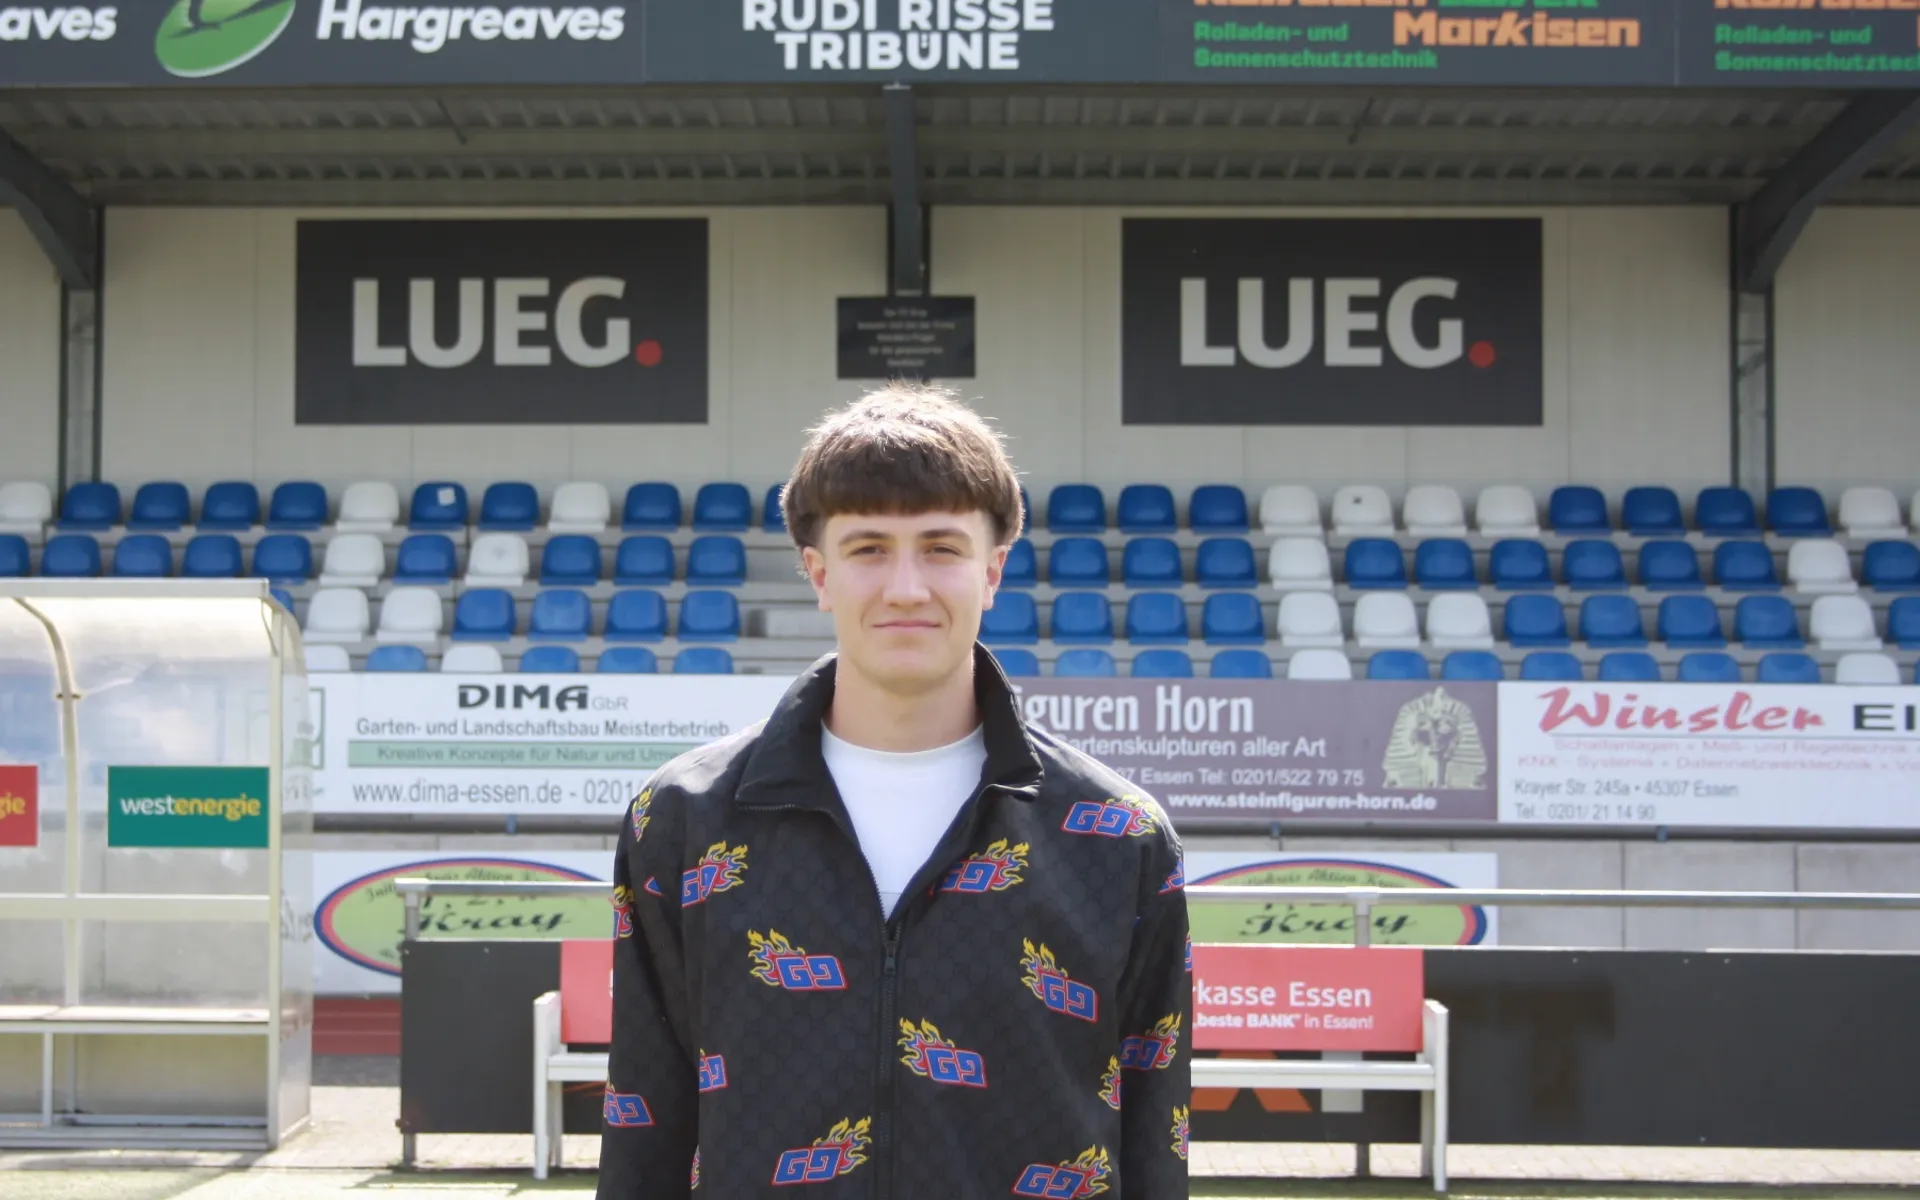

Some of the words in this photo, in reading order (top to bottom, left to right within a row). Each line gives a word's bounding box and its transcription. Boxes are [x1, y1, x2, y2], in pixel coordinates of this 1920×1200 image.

[316, 0, 626, 53] Hargreaves
[742, 0, 878, 31] RUDI
[898, 0, 1055, 31] RISSE
[1194, 21, 1303, 41] Rolladen-
[1306, 22, 1348, 42] und
[1393, 10, 1641, 47] Markisen
[1829, 24, 1872, 45] und
[774, 31, 1020, 70] TRIBÜNE
[1194, 48, 1438, 68] Sonnenschutztechnik
[1714, 51, 1920, 71] Sonnenschutztec
[458, 685, 589, 711] DIMA
[592, 697, 629, 711] GbR
[1155, 684, 1254, 733] Horn
[1537, 687, 1824, 732] Winsler
[356, 718, 422, 735] Garten-
[426, 719, 458, 736] und
[463, 720, 599, 737] Landschaftsbau
[604, 720, 730, 737] Meisterbetrieb
[377, 746, 444, 761] Kreative
[449, 746, 525, 763] Konzepte
[529, 747, 550, 761] für
[556, 748, 599, 761] Natur
[604, 748, 635, 762] und
[1056, 734, 1236, 760] artenskulpturen
[1242, 738, 1291, 757] aller
[1293, 738, 1326, 758] Art
[1141, 767, 1194, 785] Essen
[1231, 769, 1312, 786] 0201/522
[1316, 770, 1340, 786] 79
[1343, 770, 1365, 786] 75
[353, 779, 563, 804] www.dima-essen.de
[1514, 778, 1562, 799] Krayer
[1643, 781, 1690, 797] 45307
[1694, 781, 1739, 798] Essen
[120, 793, 262, 822] westenergie
[1167, 790, 1437, 812] www.steinfiguren-horn.de
[1592, 804, 1610, 820] 21
[1193, 978, 1276, 1006] kasse
[1289, 981, 1372, 1008] Essen
[1304, 1014, 1319, 1028] in
[1324, 1014, 1373, 1030] Essen!
